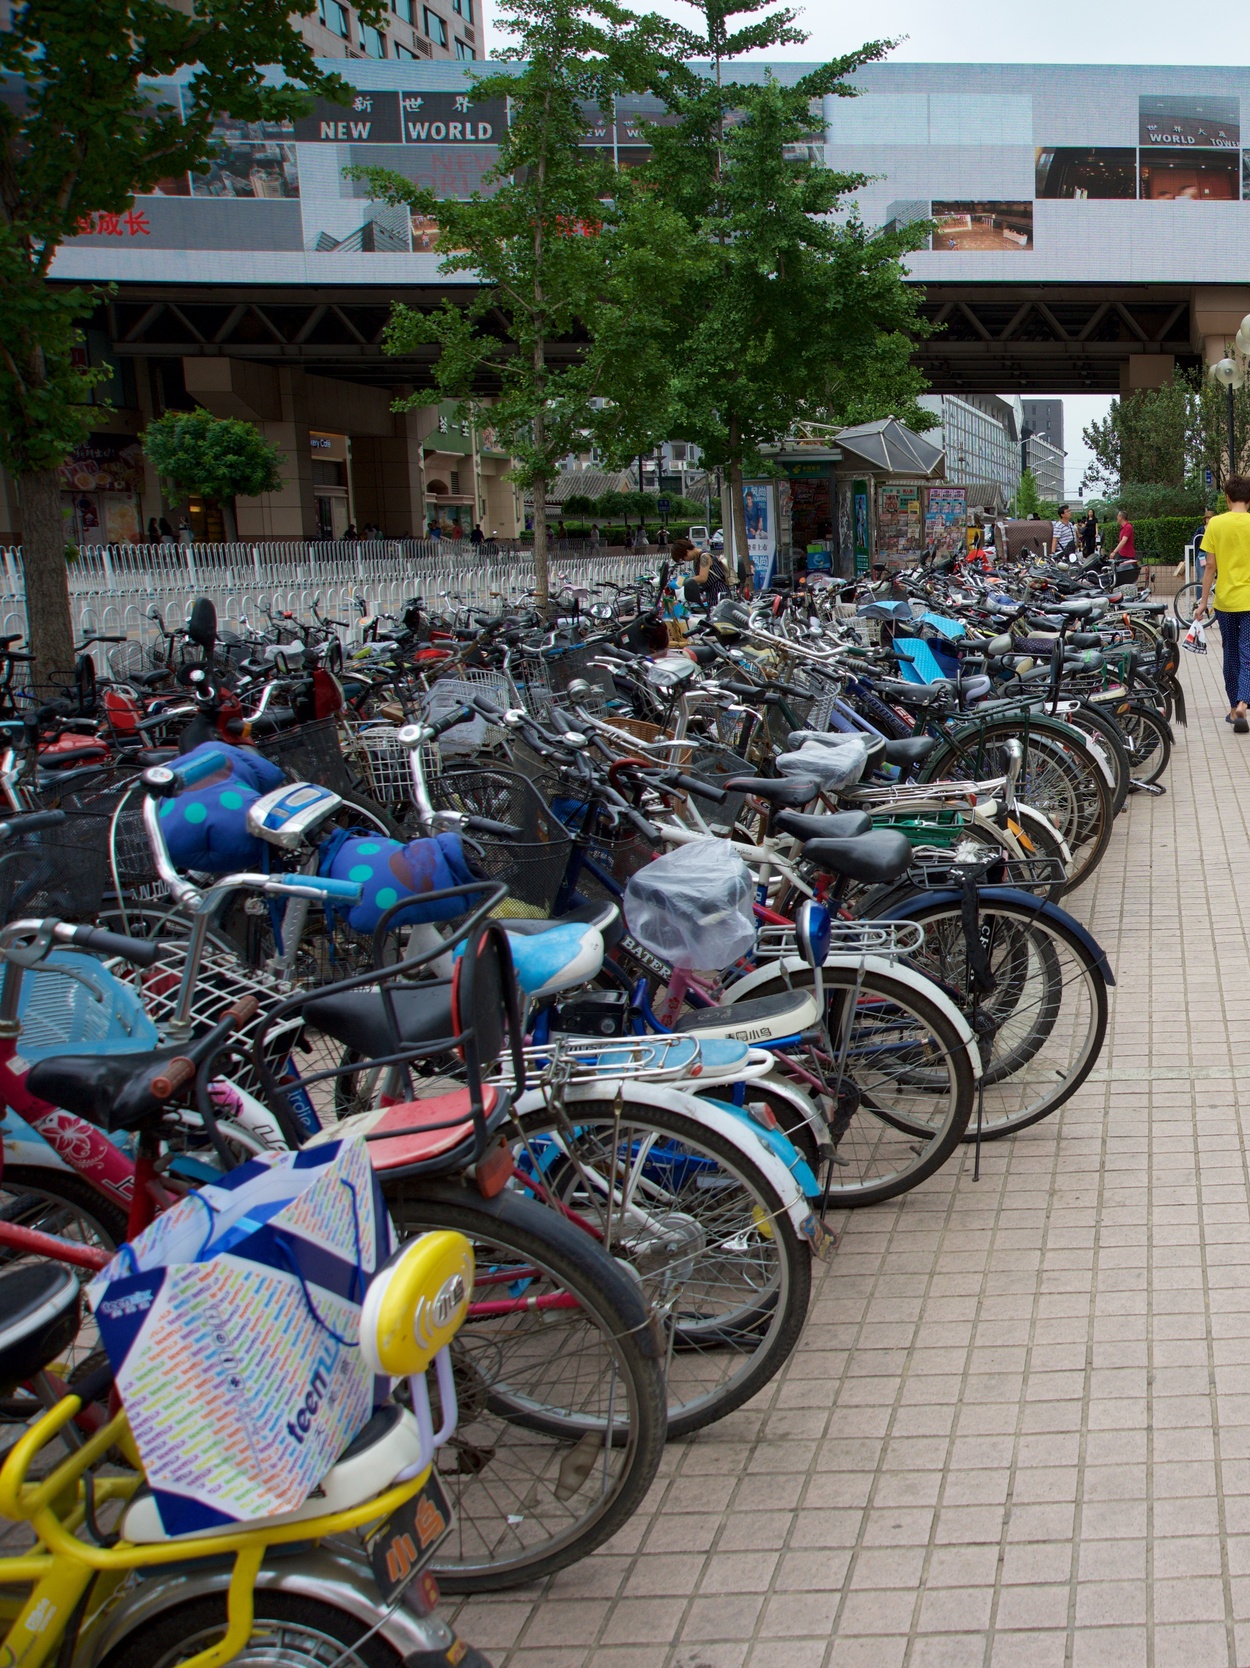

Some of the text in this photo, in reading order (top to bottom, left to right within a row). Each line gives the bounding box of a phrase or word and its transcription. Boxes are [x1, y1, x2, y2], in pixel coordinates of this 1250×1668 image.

[352, 96, 474, 113] 新世界
[320, 121, 493, 141] NEW WORLD
[1150, 133, 1195, 145] WORLD
